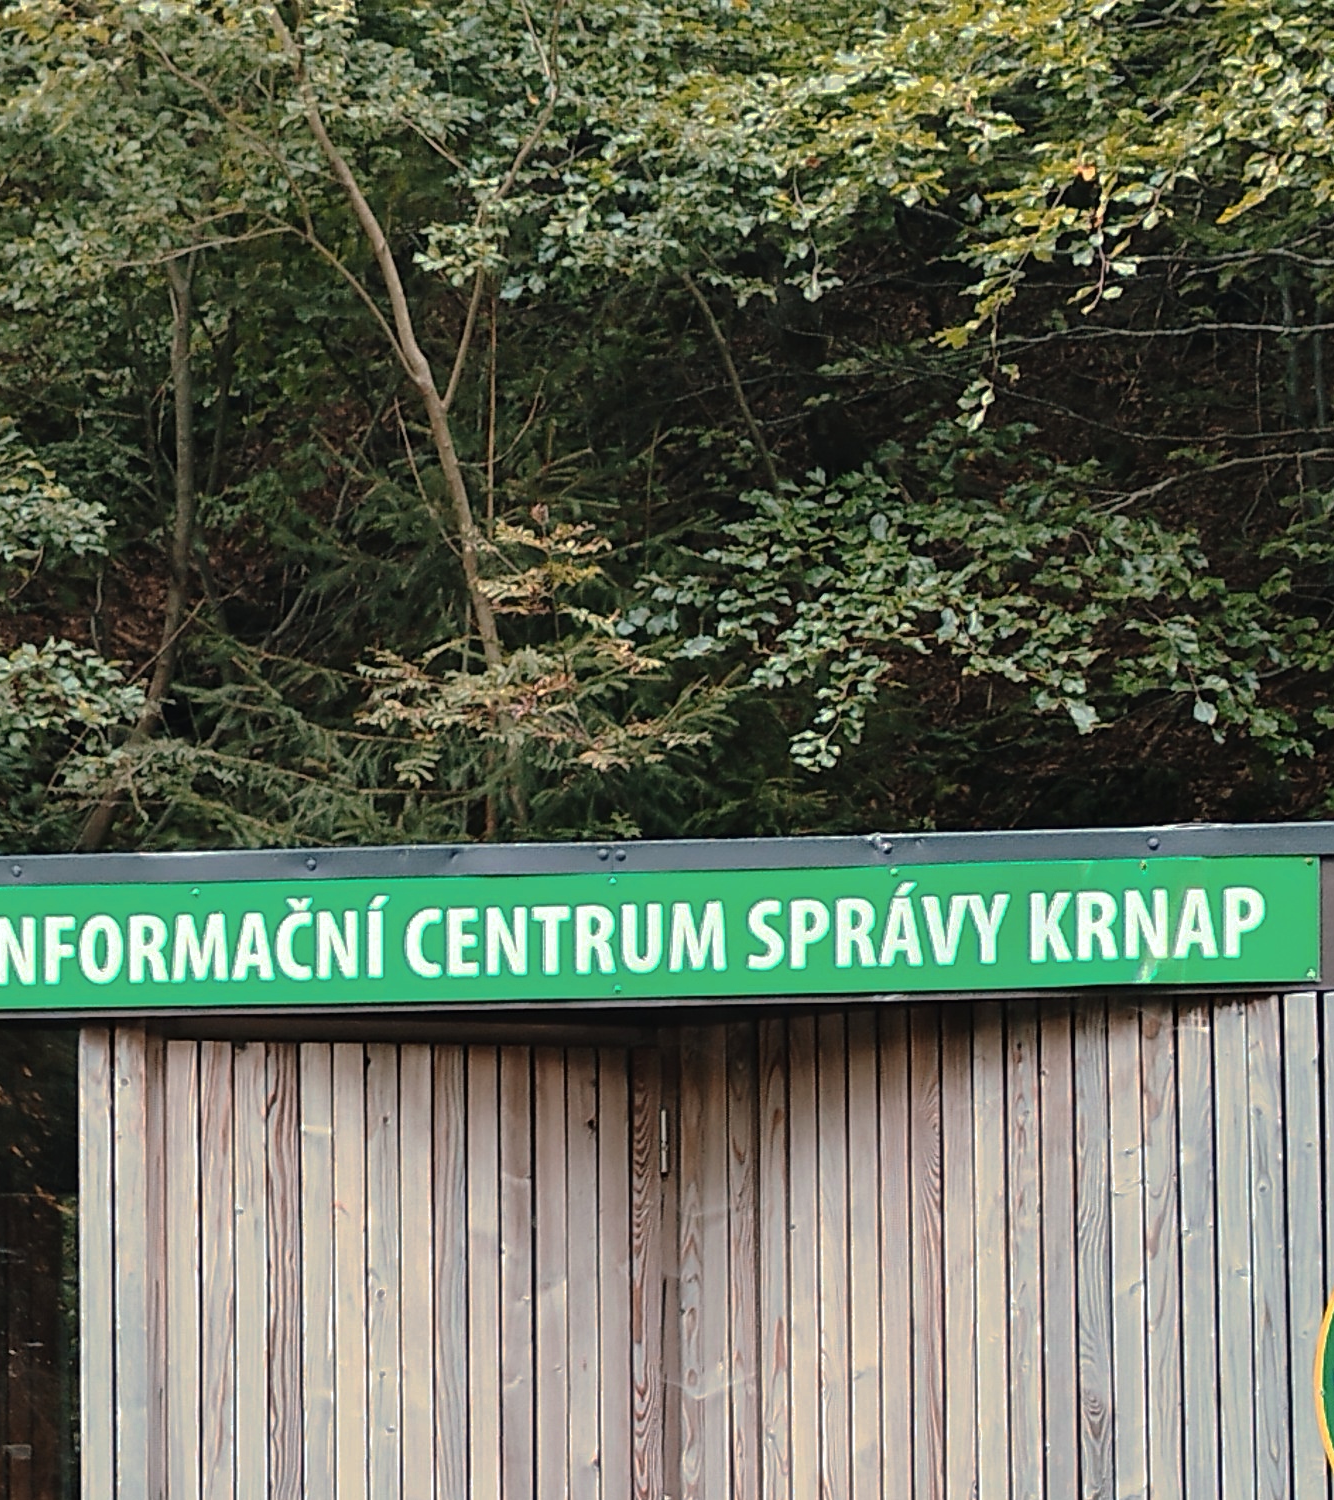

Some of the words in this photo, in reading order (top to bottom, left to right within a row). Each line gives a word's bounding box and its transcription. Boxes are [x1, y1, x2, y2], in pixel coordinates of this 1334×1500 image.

[403, 900, 728, 978] CENTRUM
[746, 881, 1011, 970] SPRÁVY
[1029, 886, 1266, 962] KRNAP
